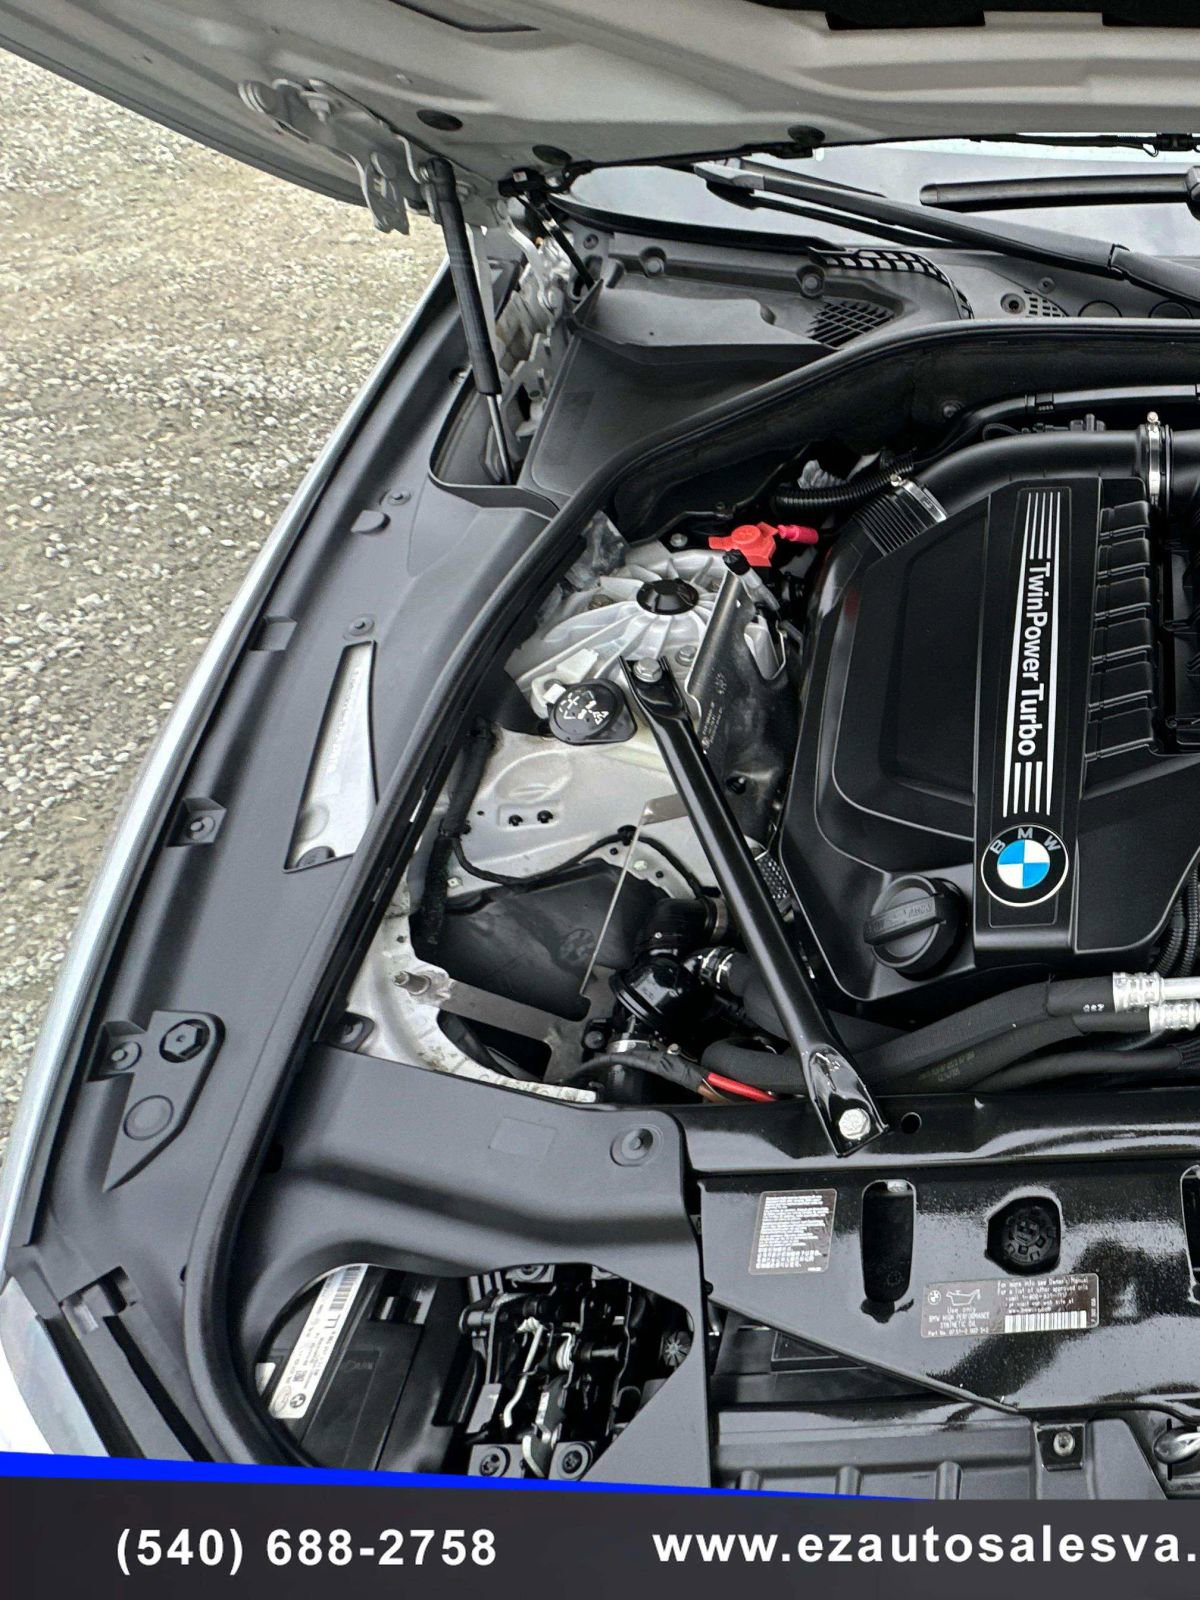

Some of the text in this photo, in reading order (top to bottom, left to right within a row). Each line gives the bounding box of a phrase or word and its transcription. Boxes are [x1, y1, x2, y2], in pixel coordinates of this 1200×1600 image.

[1017, 562, 1051, 756] TwinPower Turbo
[990, 827, 1061, 855] BMW
